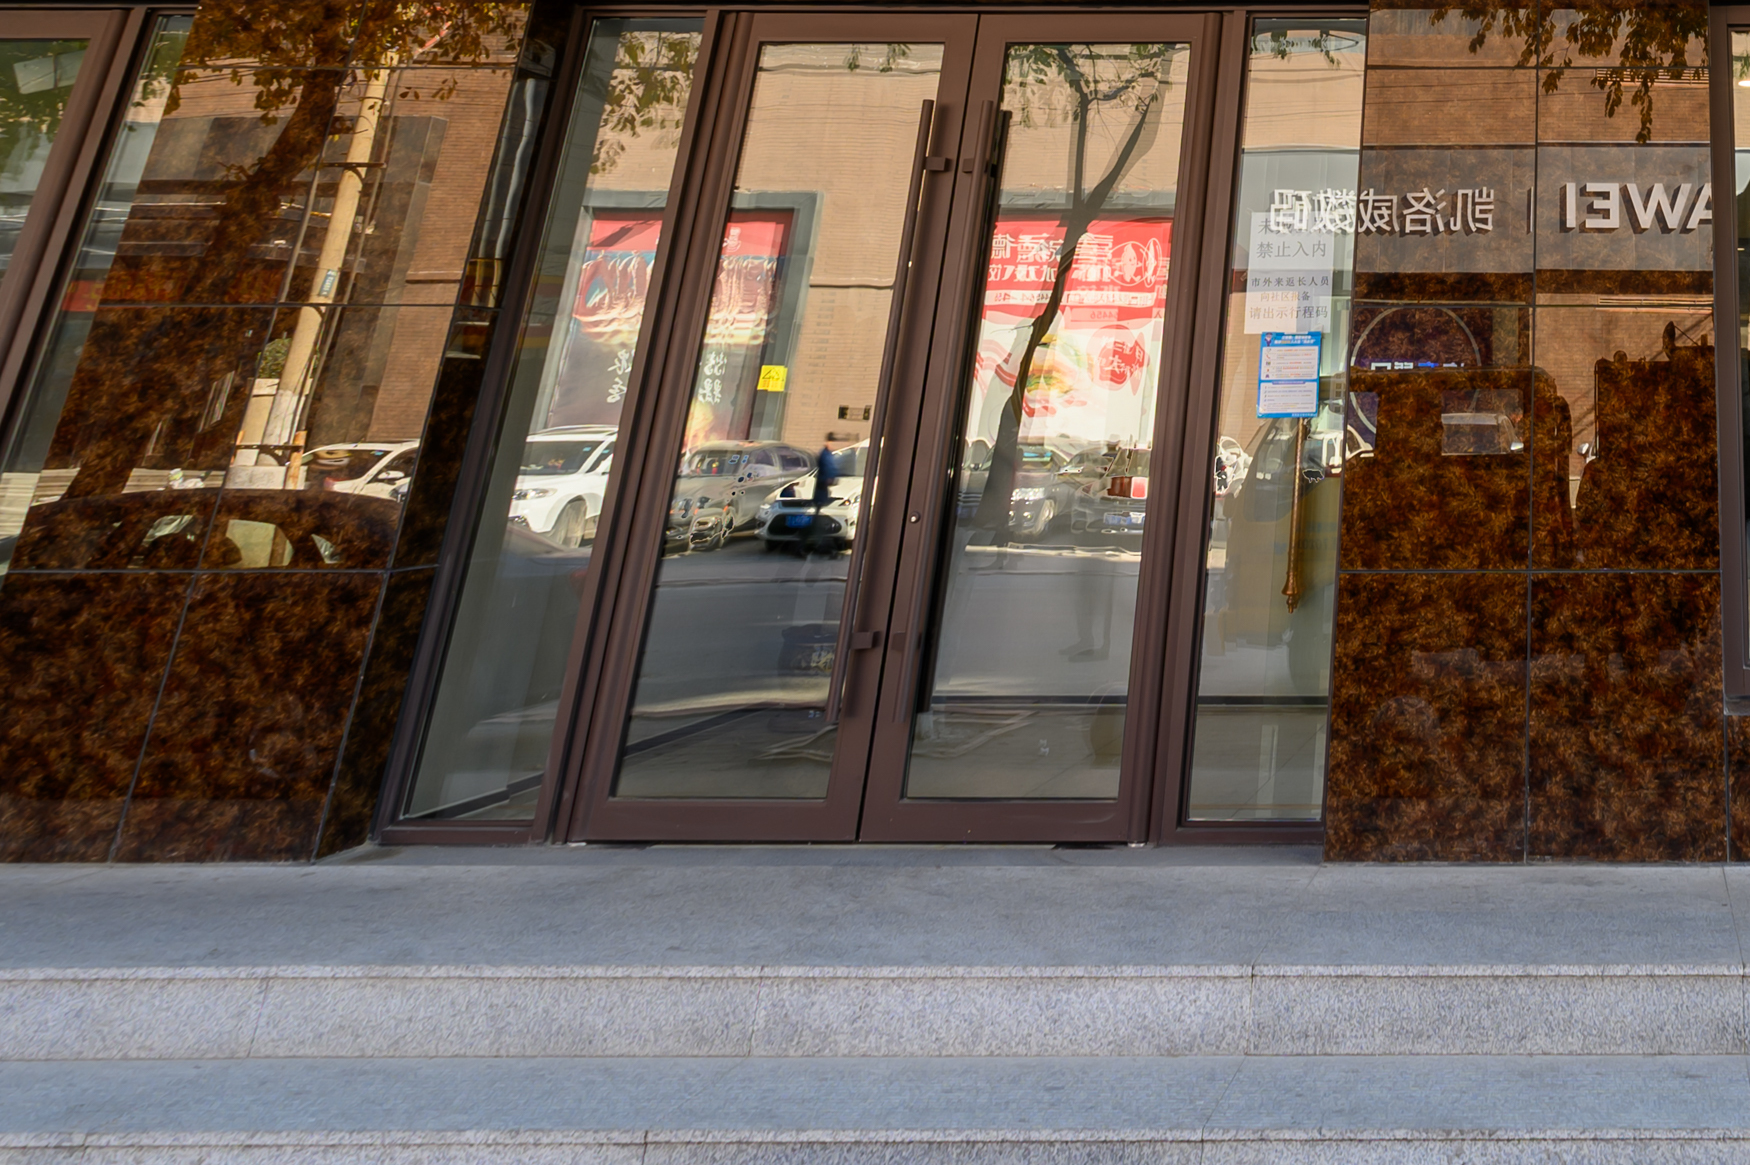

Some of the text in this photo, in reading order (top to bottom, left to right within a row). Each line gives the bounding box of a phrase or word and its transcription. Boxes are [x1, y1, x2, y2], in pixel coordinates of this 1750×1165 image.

[1256, 240, 1327, 259] 禁止入内
[1251, 276, 1330, 287] 市外来返长人员
[1249, 306, 1328, 319] 请出示行程码
